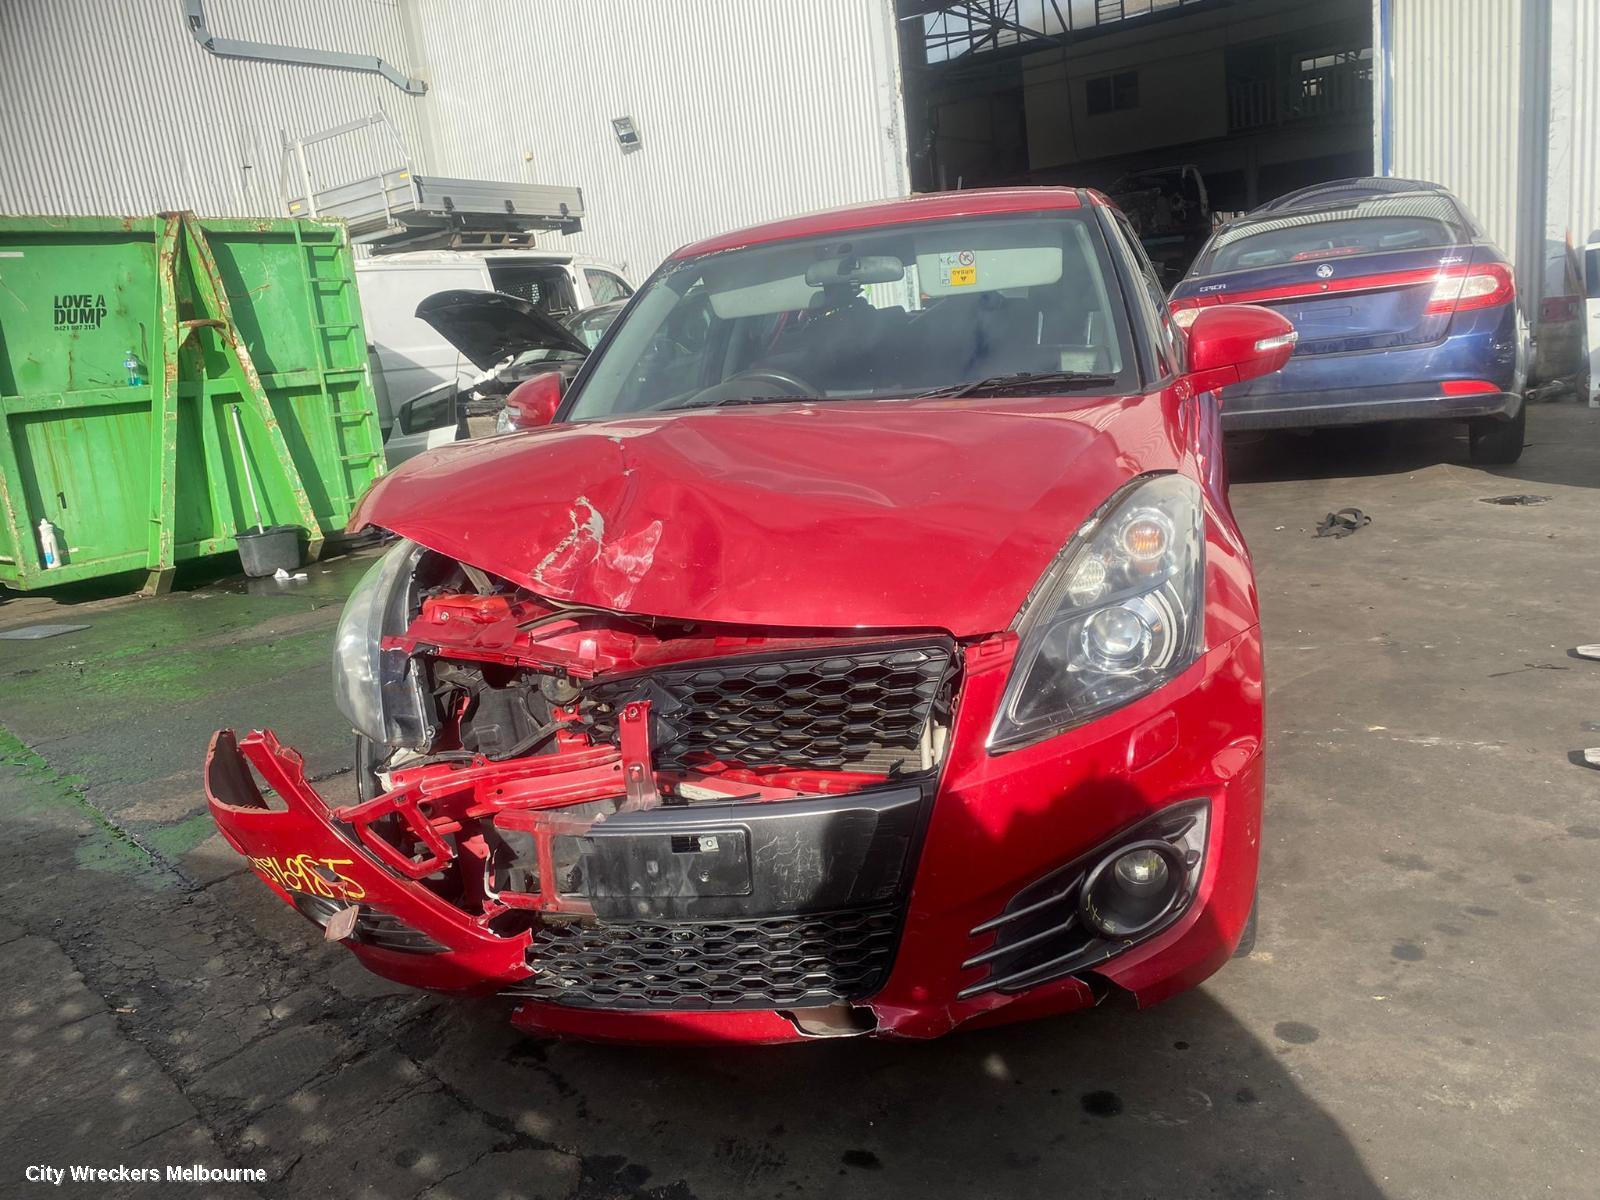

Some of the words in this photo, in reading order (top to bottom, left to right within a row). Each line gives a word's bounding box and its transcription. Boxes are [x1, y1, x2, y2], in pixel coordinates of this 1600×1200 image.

[54, 294, 92, 308] LOVE
[95, 294, 106, 308] A
[54, 308, 107, 328] DUMP
